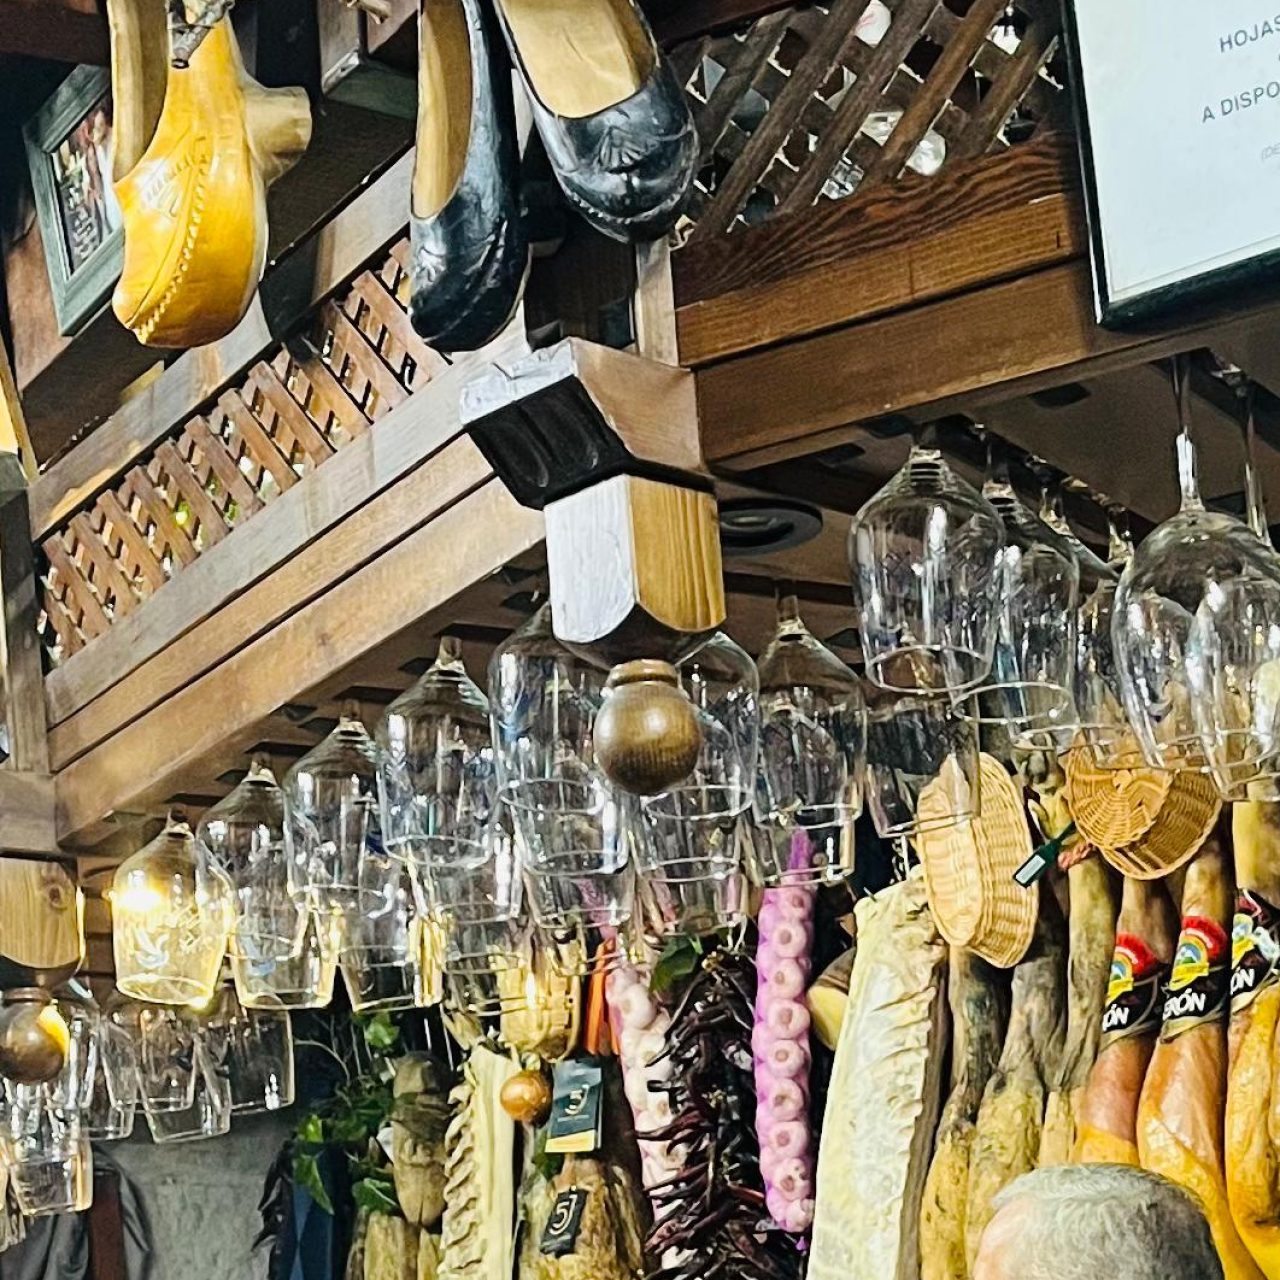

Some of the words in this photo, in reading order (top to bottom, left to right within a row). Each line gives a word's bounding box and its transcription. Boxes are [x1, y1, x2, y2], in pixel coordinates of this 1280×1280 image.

[1202, 105, 1216, 122] A
[1230, 966, 1256, 996] ÓN
[1102, 1003, 1130, 1032] ÓN
